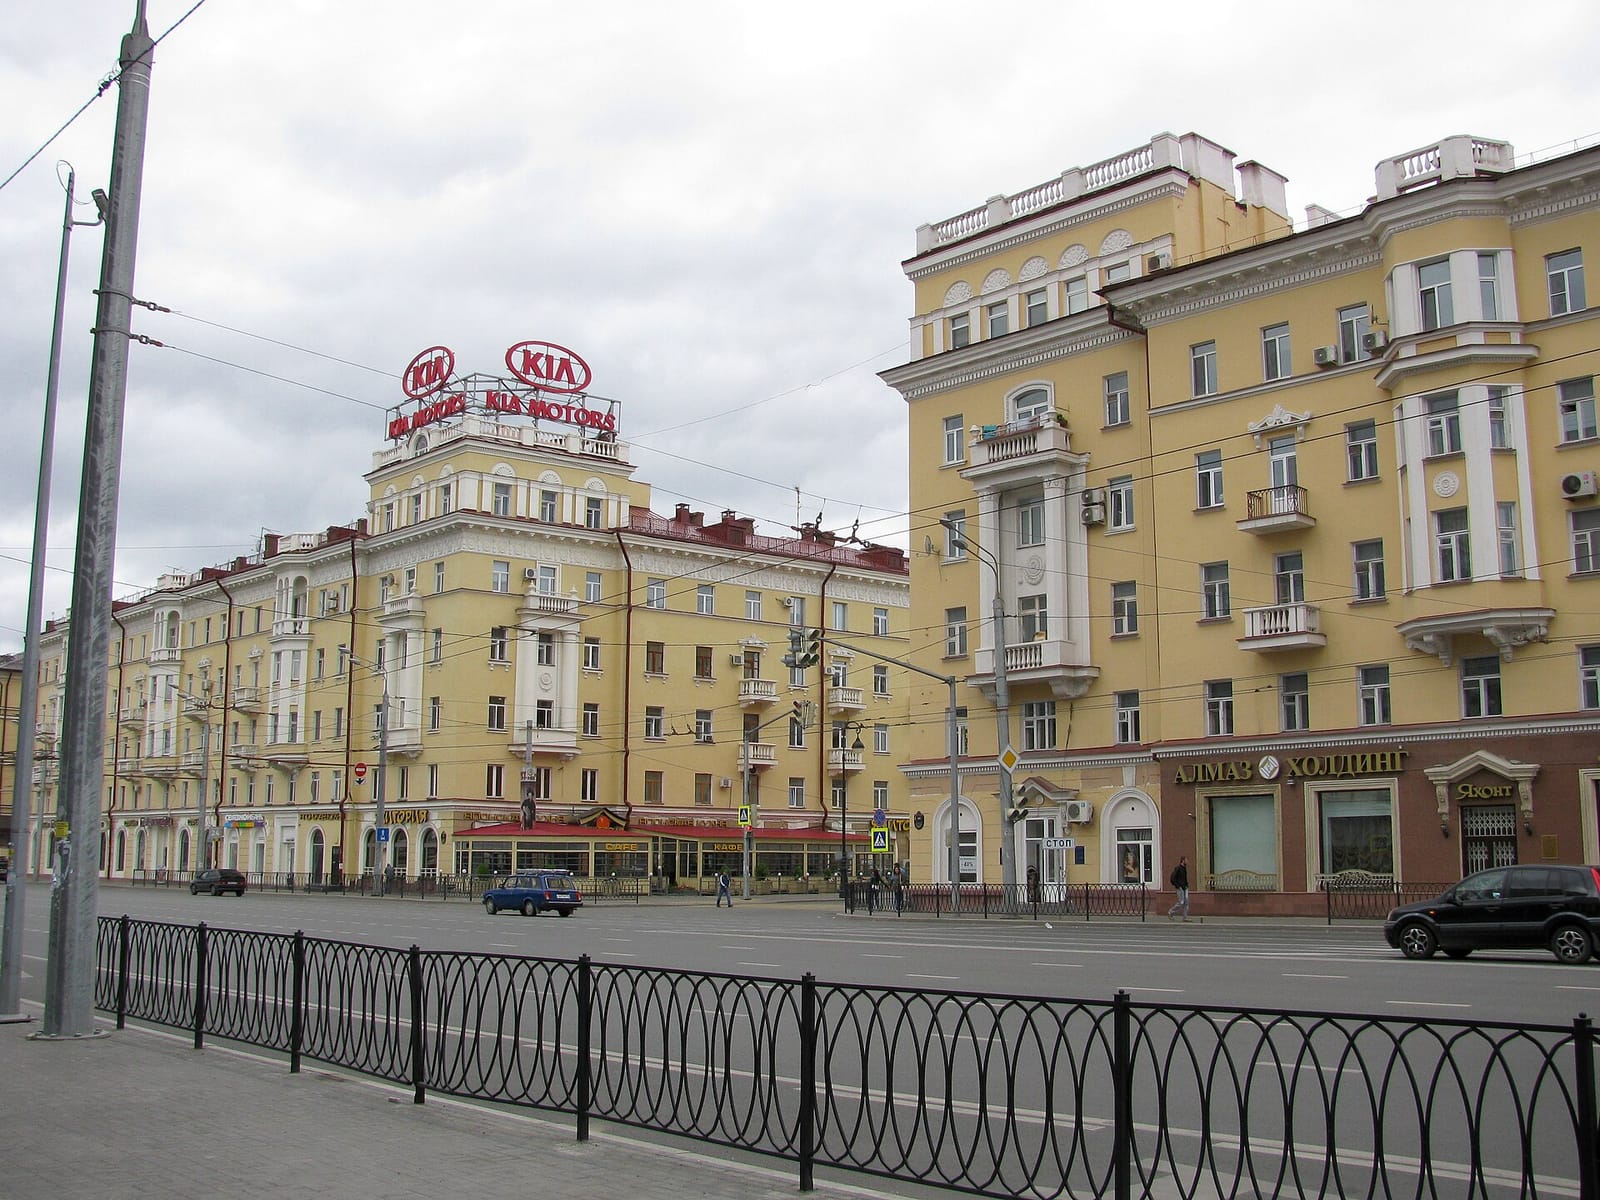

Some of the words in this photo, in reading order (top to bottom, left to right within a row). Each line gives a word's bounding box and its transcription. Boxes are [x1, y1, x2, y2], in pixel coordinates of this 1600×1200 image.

[411, 356, 445, 391] KIA
[522, 349, 576, 385] KIA
[389, 416, 410, 439] KIA
[412, 392, 466, 429] MOTORS
[486, 390, 521, 415] KIA
[528, 399, 616, 431] MOTORS
[1174, 760, 1252, 784] АЛМАЗ
[1286, 751, 1409, 778] ХОЛДИНГ
[383, 809, 430, 825] ИТОРИЯ
[605, 843, 637, 851] CAFE
[714, 843, 743, 851] КАФЕ
[1046, 839, 1072, 848] СТОП
